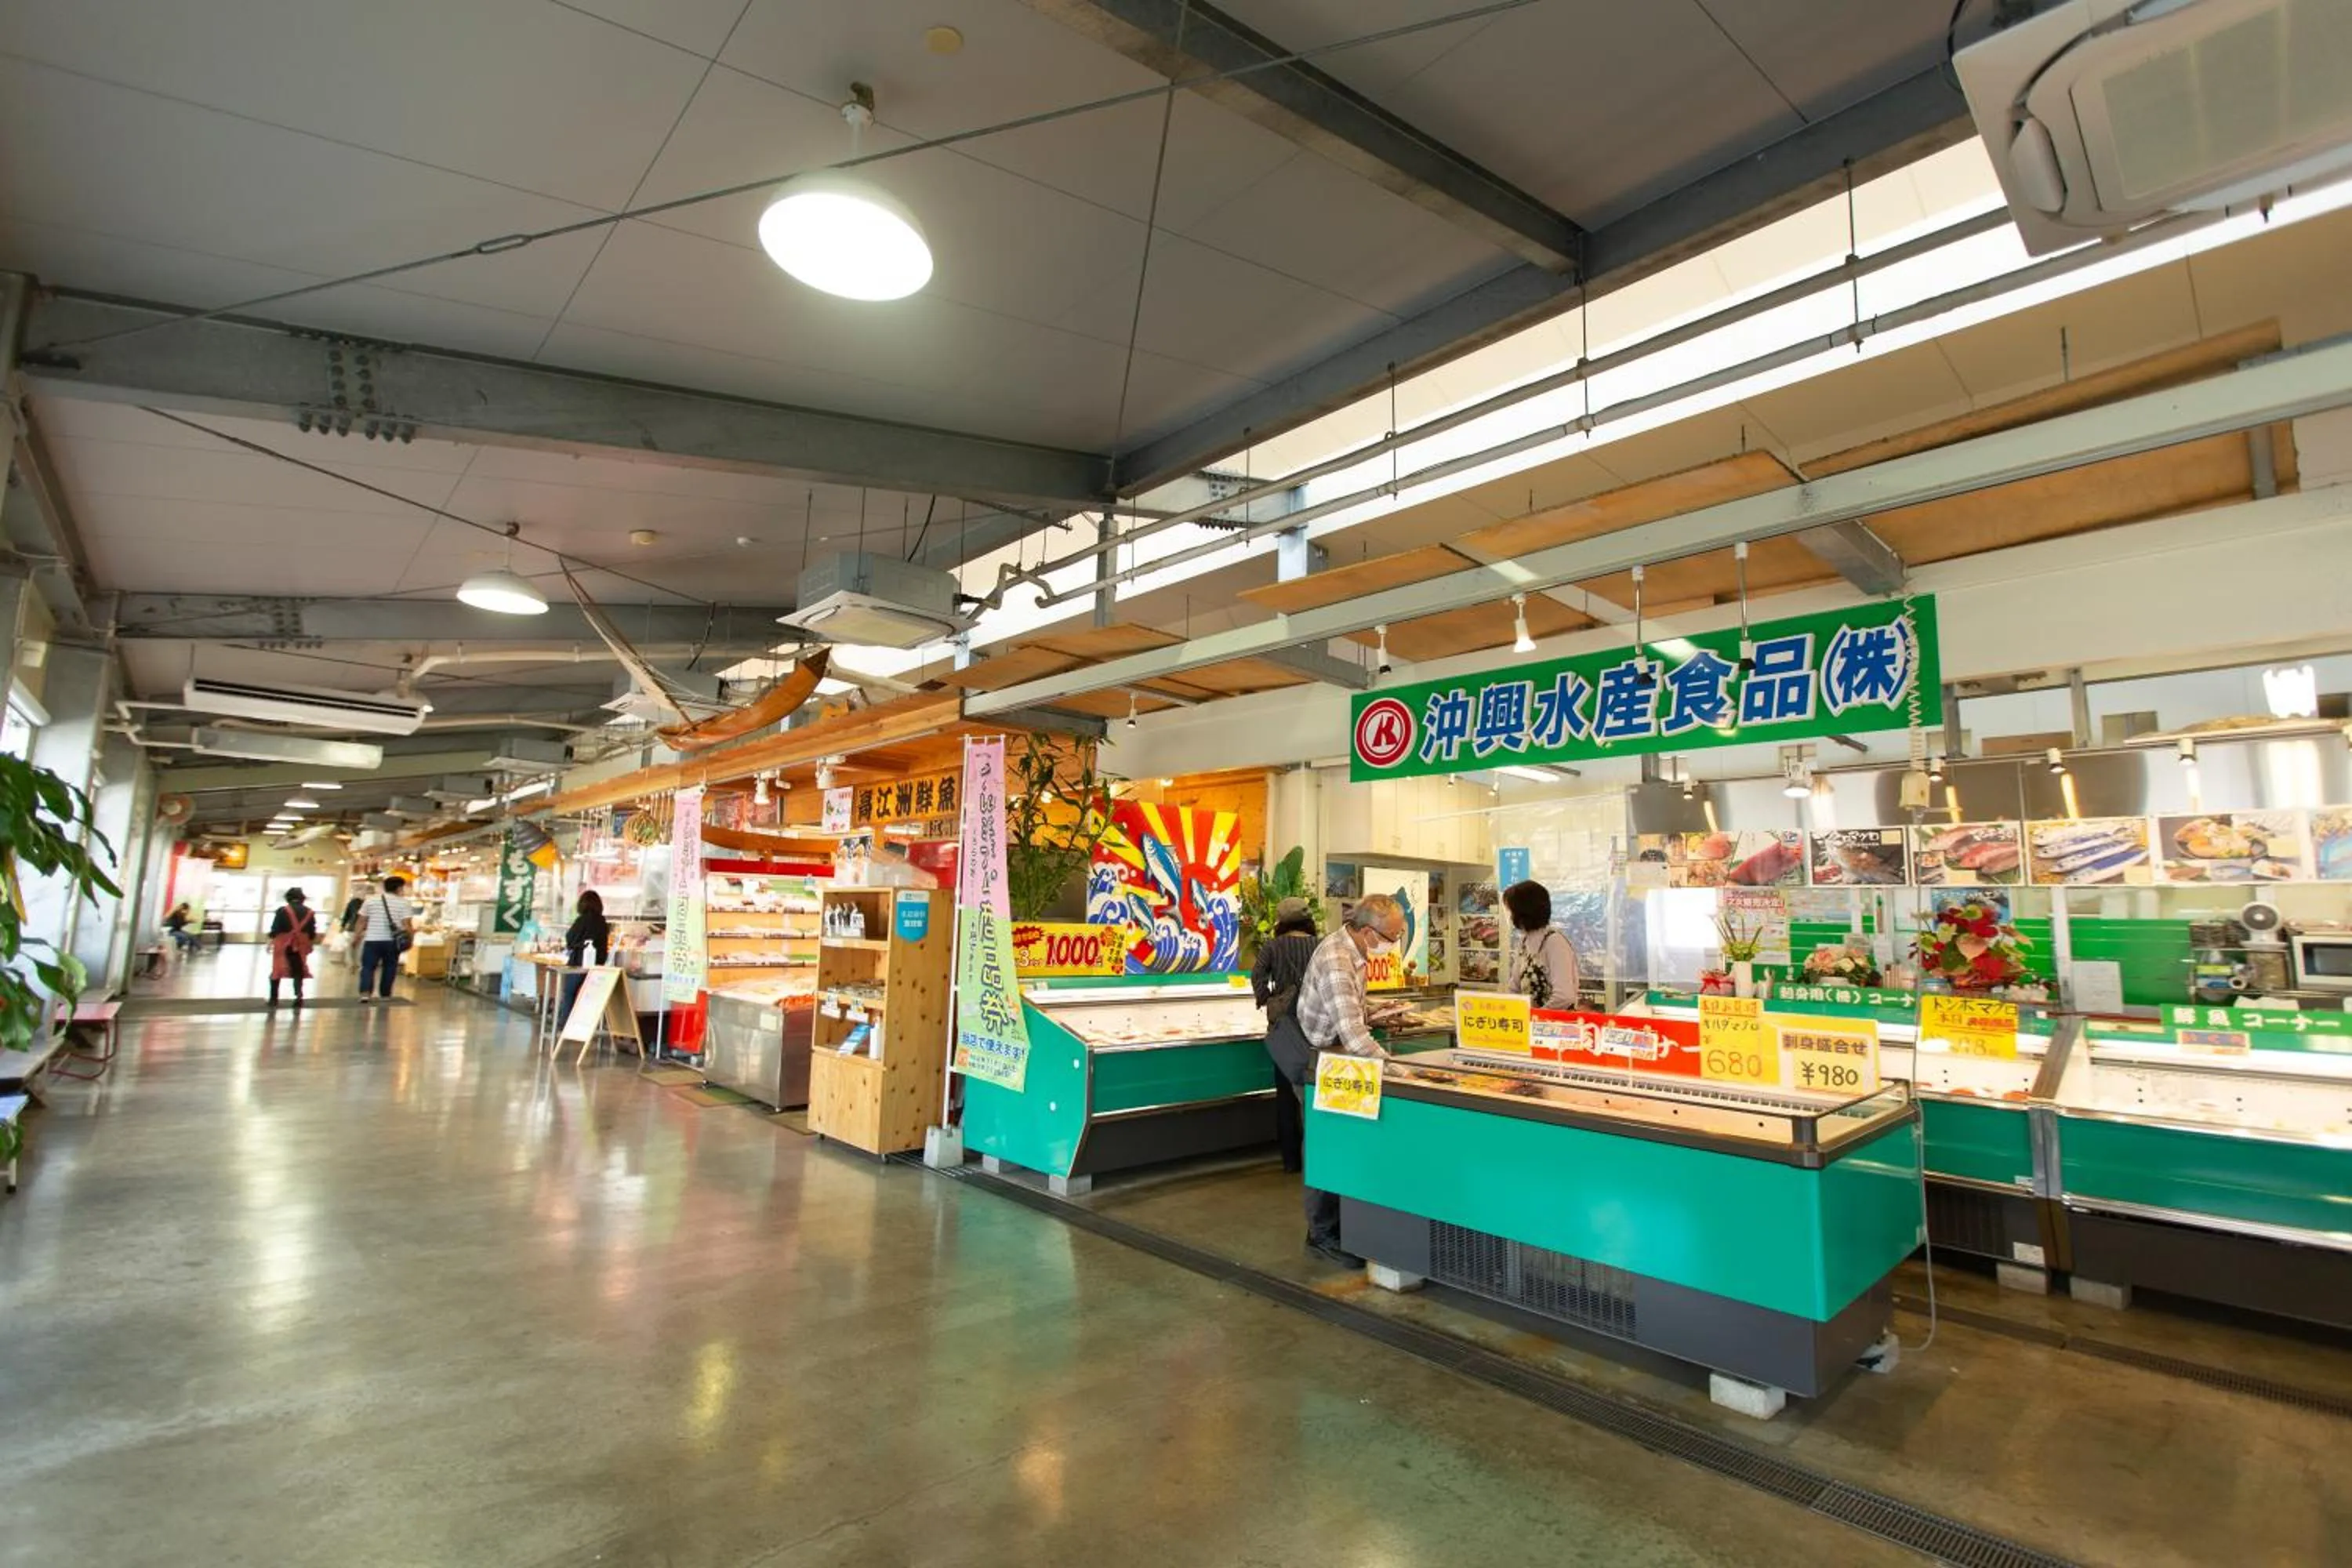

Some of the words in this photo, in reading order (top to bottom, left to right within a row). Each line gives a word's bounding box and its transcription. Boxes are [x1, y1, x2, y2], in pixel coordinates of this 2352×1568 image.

[1420, 620, 1909, 763] 沖興水産食品（株）
[1464, 1015, 1523, 1033] にぎり寿司
[1782, 1033, 1868, 1057] 刺身盛合せ
[1707, 1049, 1763, 1078] 680
[1800, 1061, 1860, 1087] ¥980
